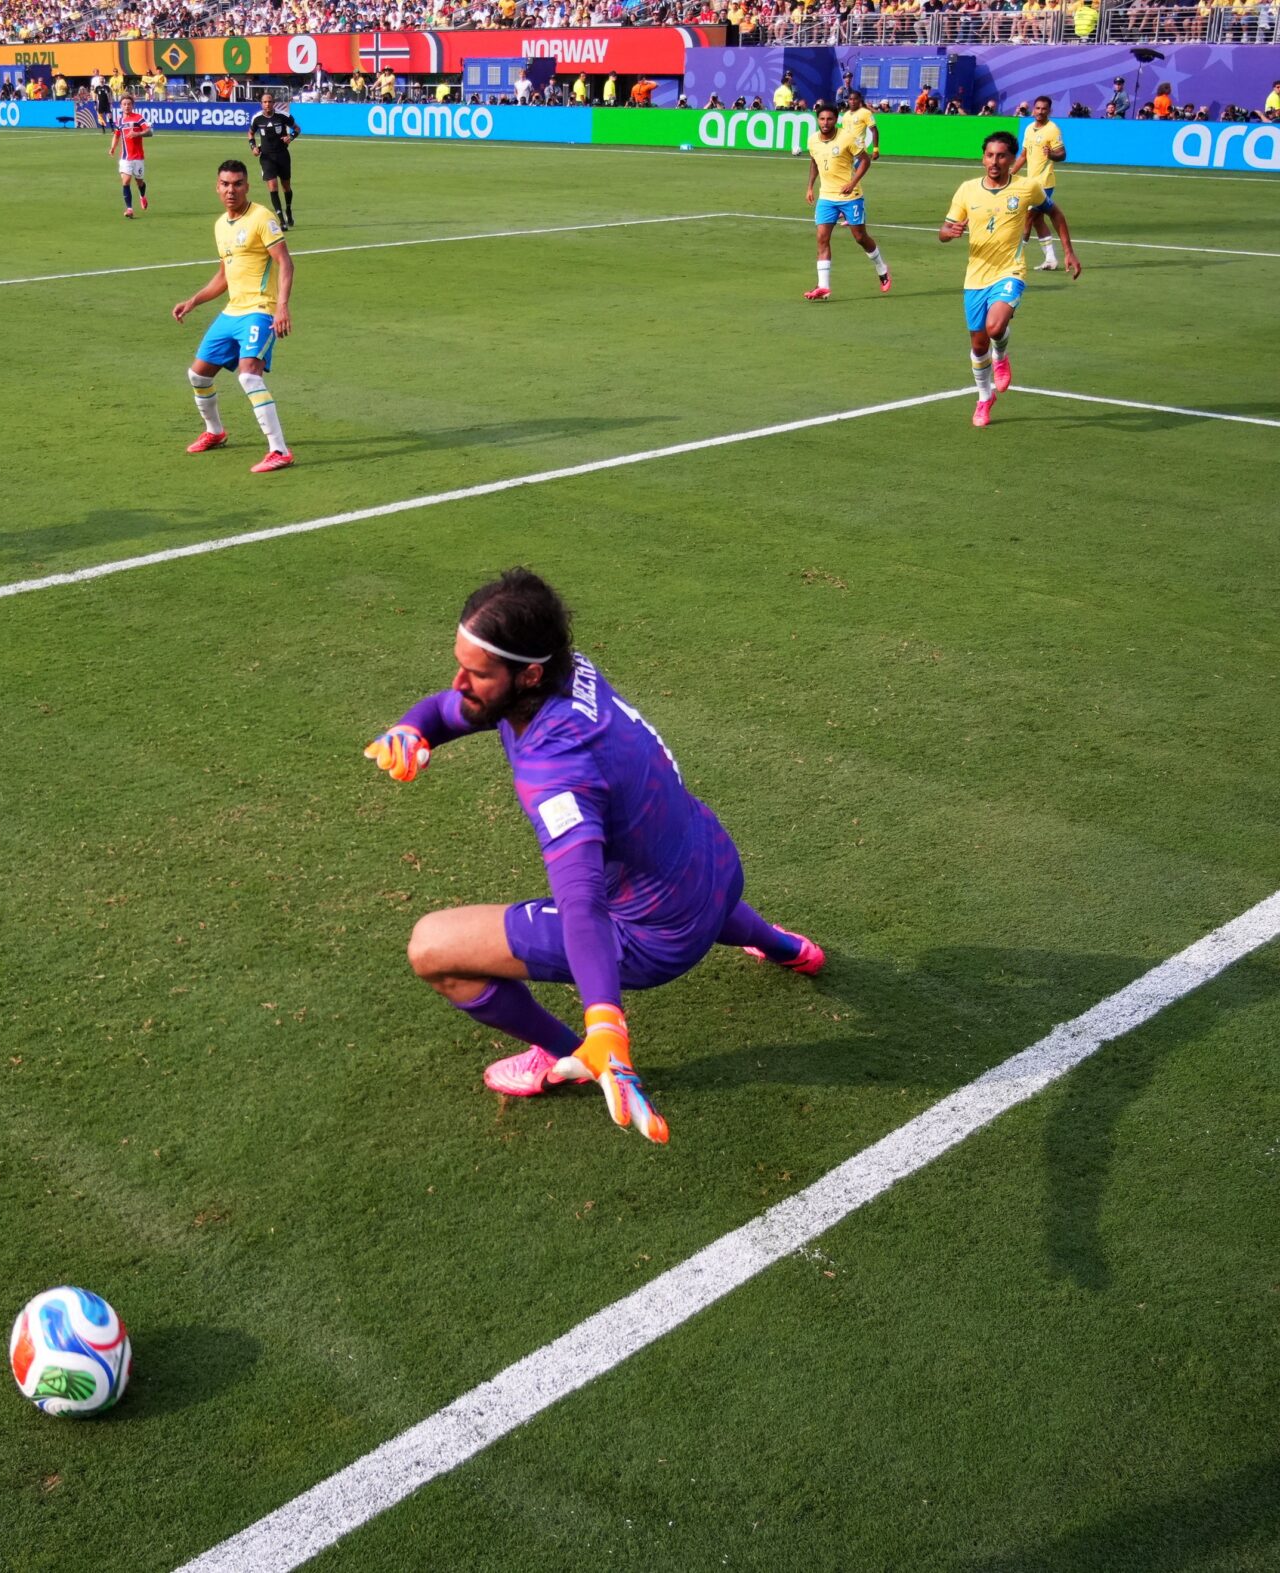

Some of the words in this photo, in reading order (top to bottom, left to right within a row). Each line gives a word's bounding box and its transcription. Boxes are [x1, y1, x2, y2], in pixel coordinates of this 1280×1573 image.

[223, 36, 251, 74] 0
[288, 35, 317, 74] 0
[522, 38, 609, 63] NORWAY
[15, 52, 58, 68] BRAZIL
[175, 108, 200, 125] CUP
[201, 109, 246, 126] 2026
[368, 105, 493, 138] aramco
[852, 204, 860, 217] 2
[985, 216, 995, 233] 4
[1003, 281, 1013, 293] 4
